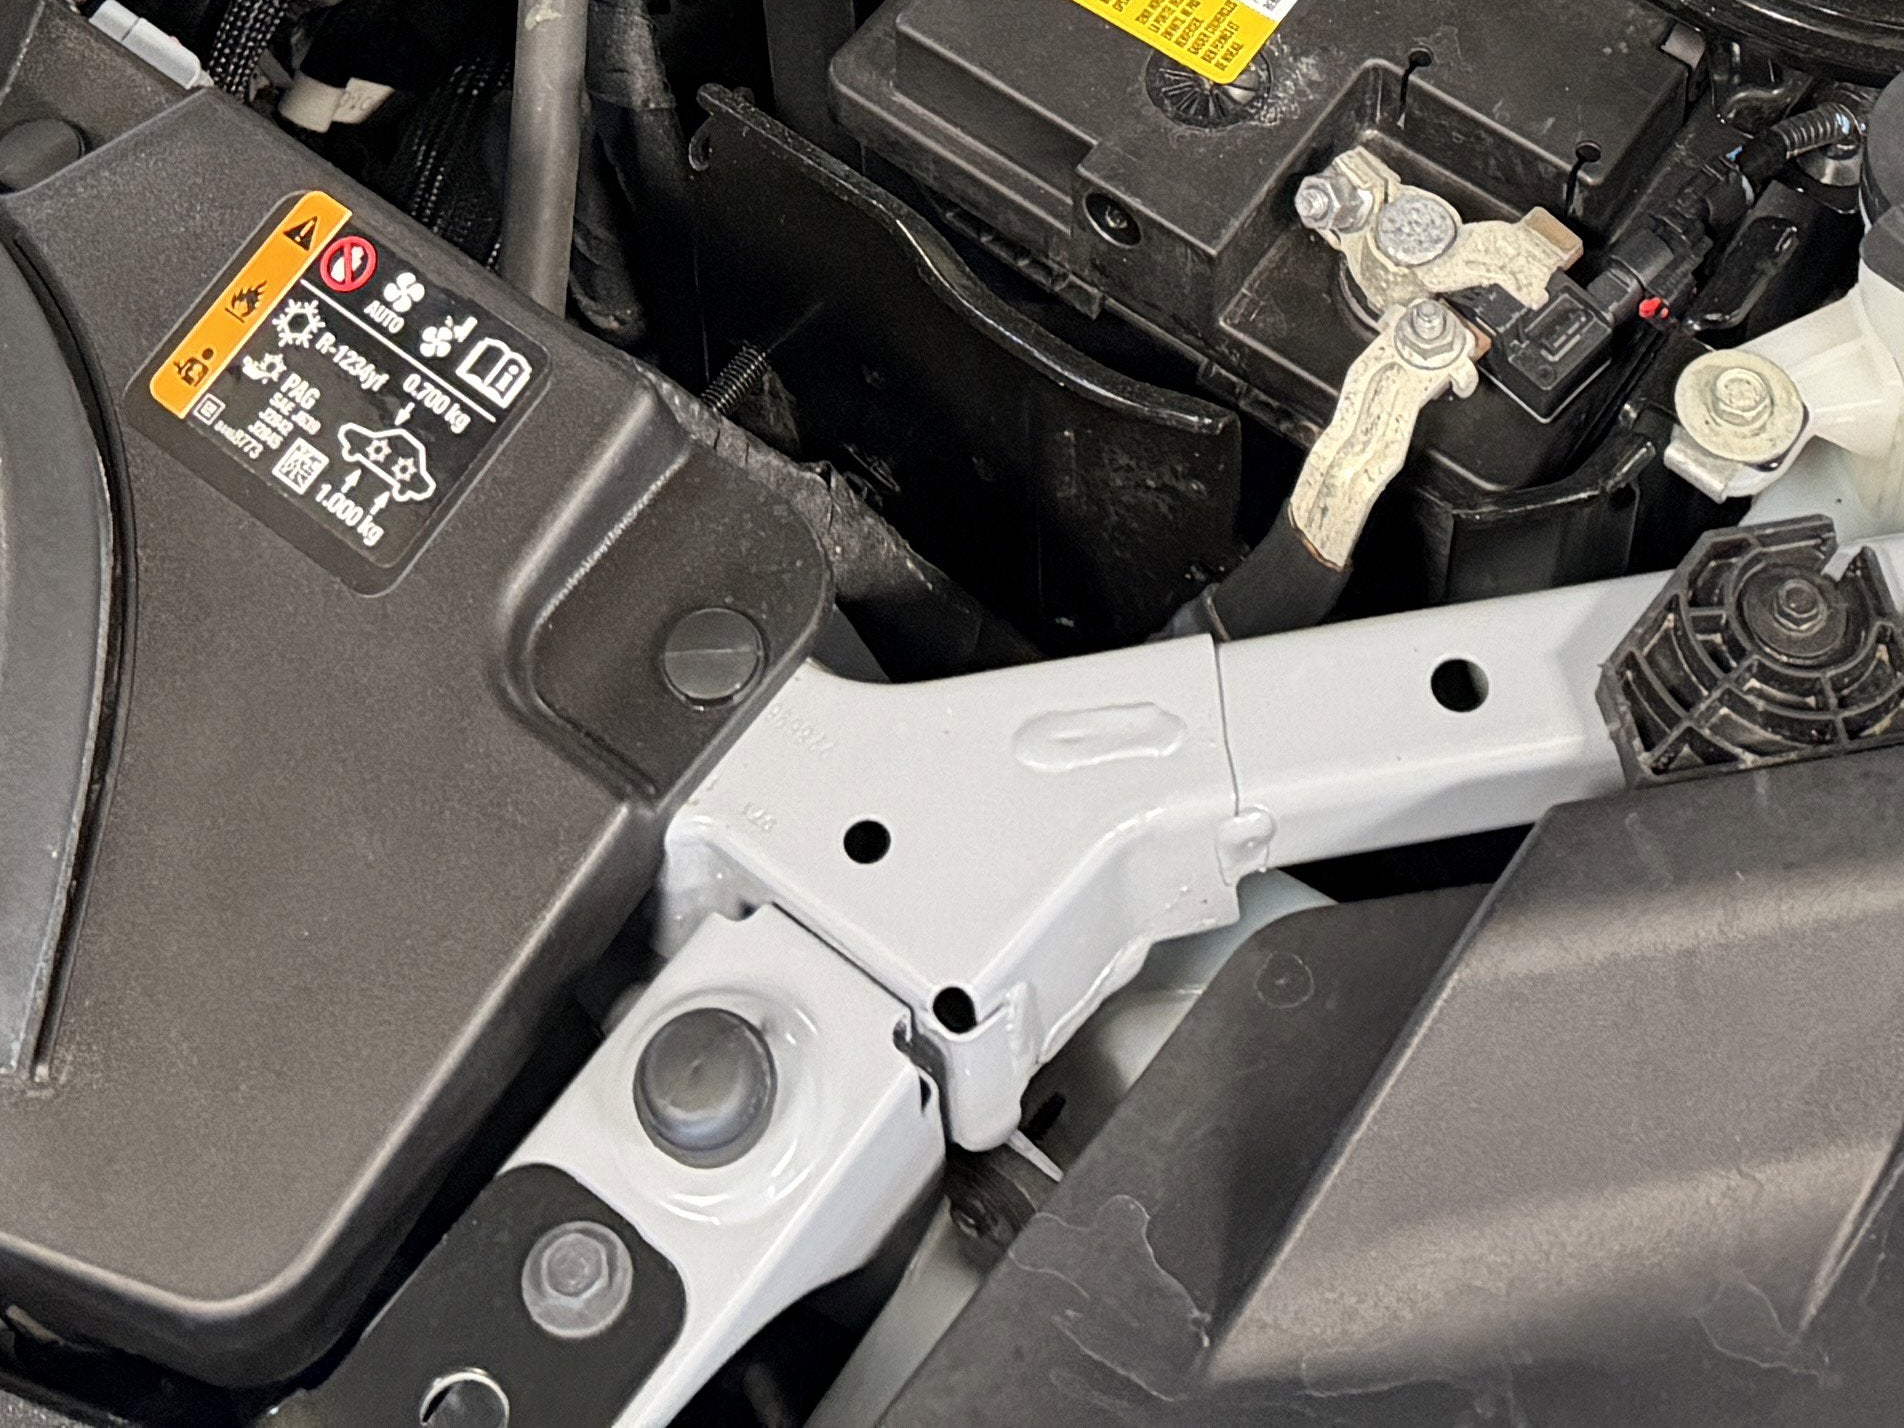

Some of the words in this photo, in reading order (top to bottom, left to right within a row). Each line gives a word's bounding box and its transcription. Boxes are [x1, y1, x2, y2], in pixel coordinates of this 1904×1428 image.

[363, 300, 405, 333] AUTO
[314, 332, 390, 393] R-1234yf
[268, 392, 295, 418] SAE
[280, 372, 321, 410] PAG
[402, 372, 449, 413] 0.700
[442, 401, 472, 434] kg
[315, 482, 367, 527] 1.000
[357, 515, 385, 547] kg
